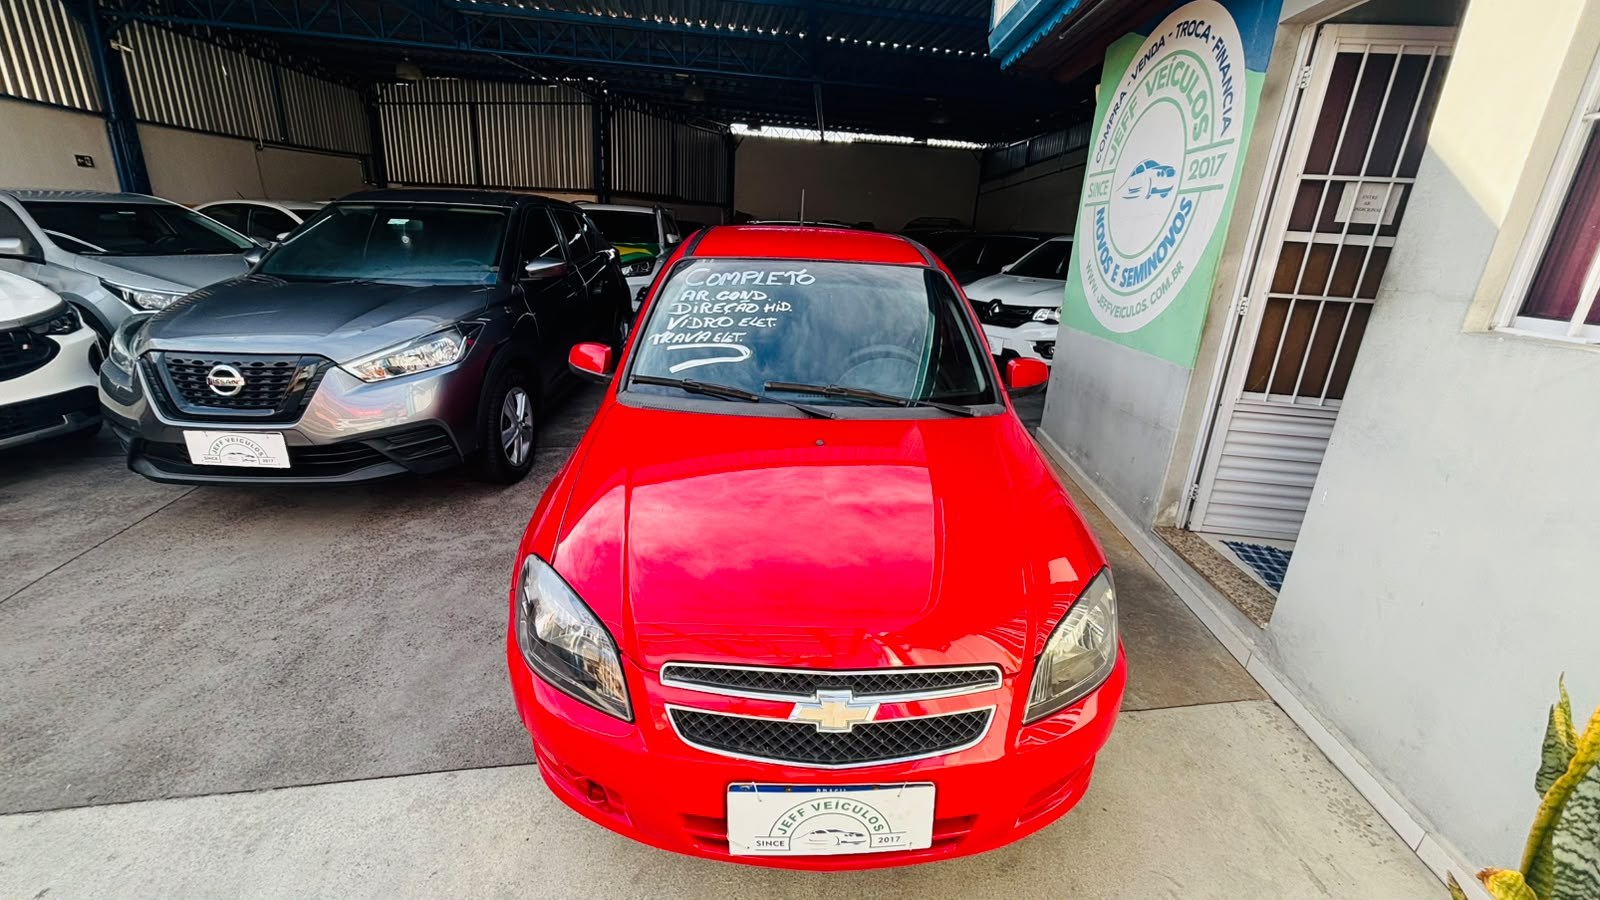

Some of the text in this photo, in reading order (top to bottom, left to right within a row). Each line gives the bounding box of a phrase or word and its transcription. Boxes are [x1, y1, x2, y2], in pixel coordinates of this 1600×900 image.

[1096, 91, 1127, 163] COMPRA
[1131, 36, 1165, 80] VENDA
[1175, 20, 1212, 43] TROCA
[1211, 36, 1235, 136] FINANCIA
[1109, 56, 1209, 165] JEFF VEÍCULOS
[1088, 153, 1227, 198] SINCE 2017
[1096, 197, 1192, 288] NOVOS E SEMINOVOS
[685, 267, 816, 286] COMPLETO
[648, 329, 711, 345] TRAVA
[212, 440, 224, 454] JEFF
[777, 799, 885, 835] JEFF VEÍCULOS
[878, 836, 901, 844] 2017
